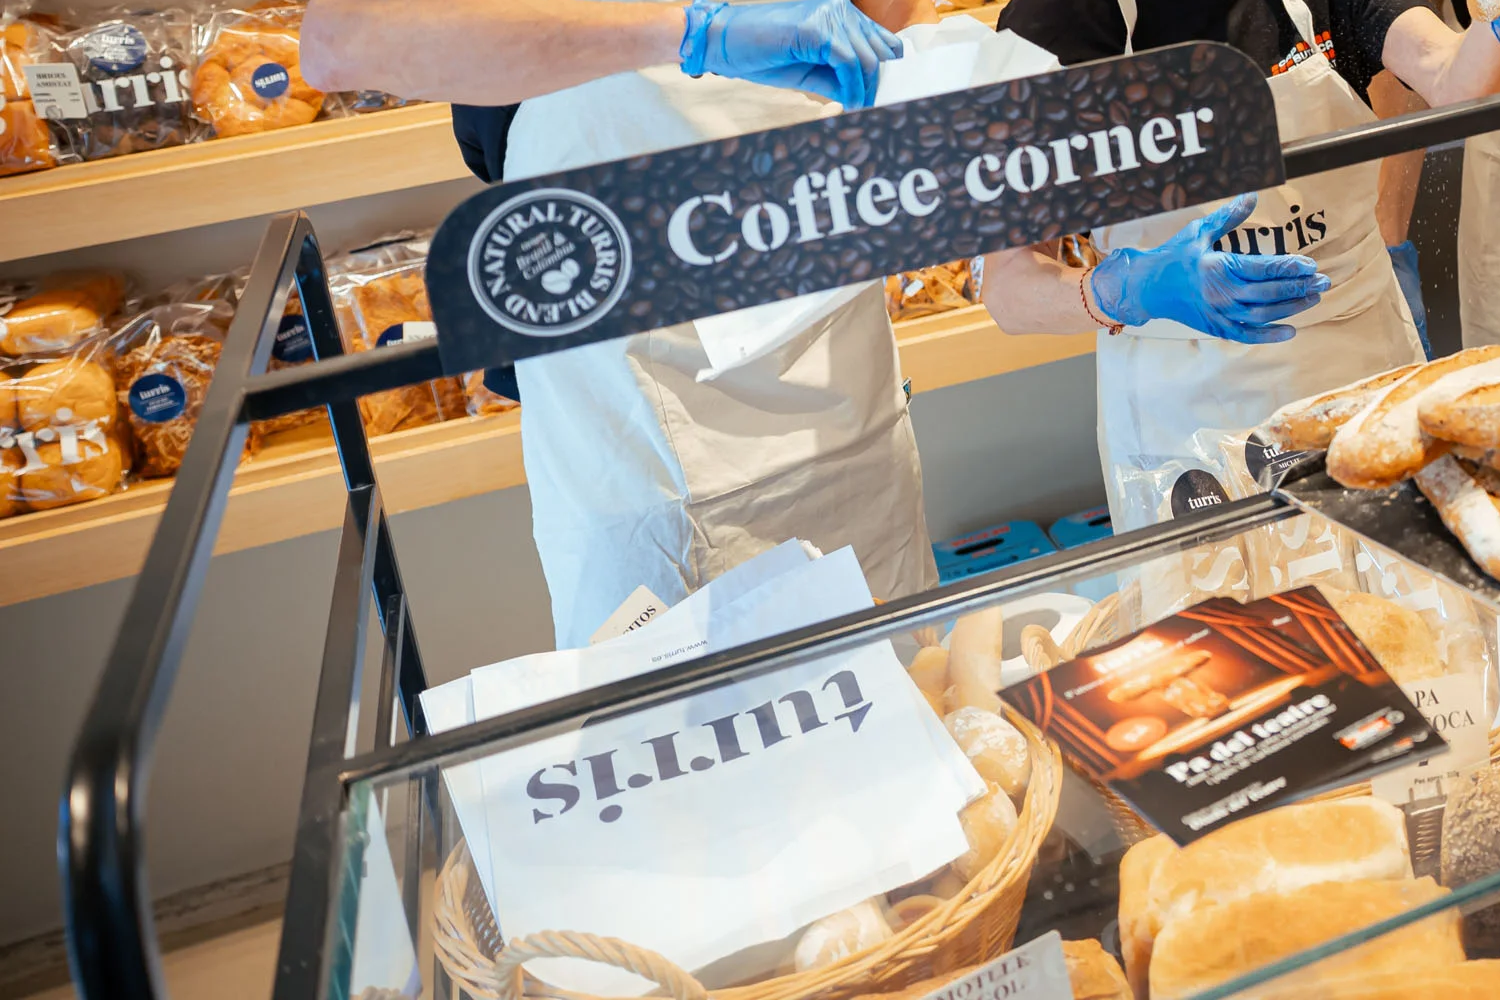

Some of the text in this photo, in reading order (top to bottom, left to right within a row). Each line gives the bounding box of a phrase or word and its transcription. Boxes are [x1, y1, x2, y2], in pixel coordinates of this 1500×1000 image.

[101, 33, 136, 46] turris
[1278, 46, 1297, 68] CAP
[1292, 39, 1334, 64] BUTCA
[254, 71, 288, 89] turris
[667, 107, 1214, 266] Coffee corner
[484, 202, 617, 323] NATURAL TURRIS BLEND
[139, 384, 171, 400] turris
[1187, 491, 1222, 510] turris
[622, 604, 657, 635] ITOS
[1414, 688, 1440, 708] PA
[525, 669, 873, 824] turris
[1165, 756, 1211, 783] Pa
